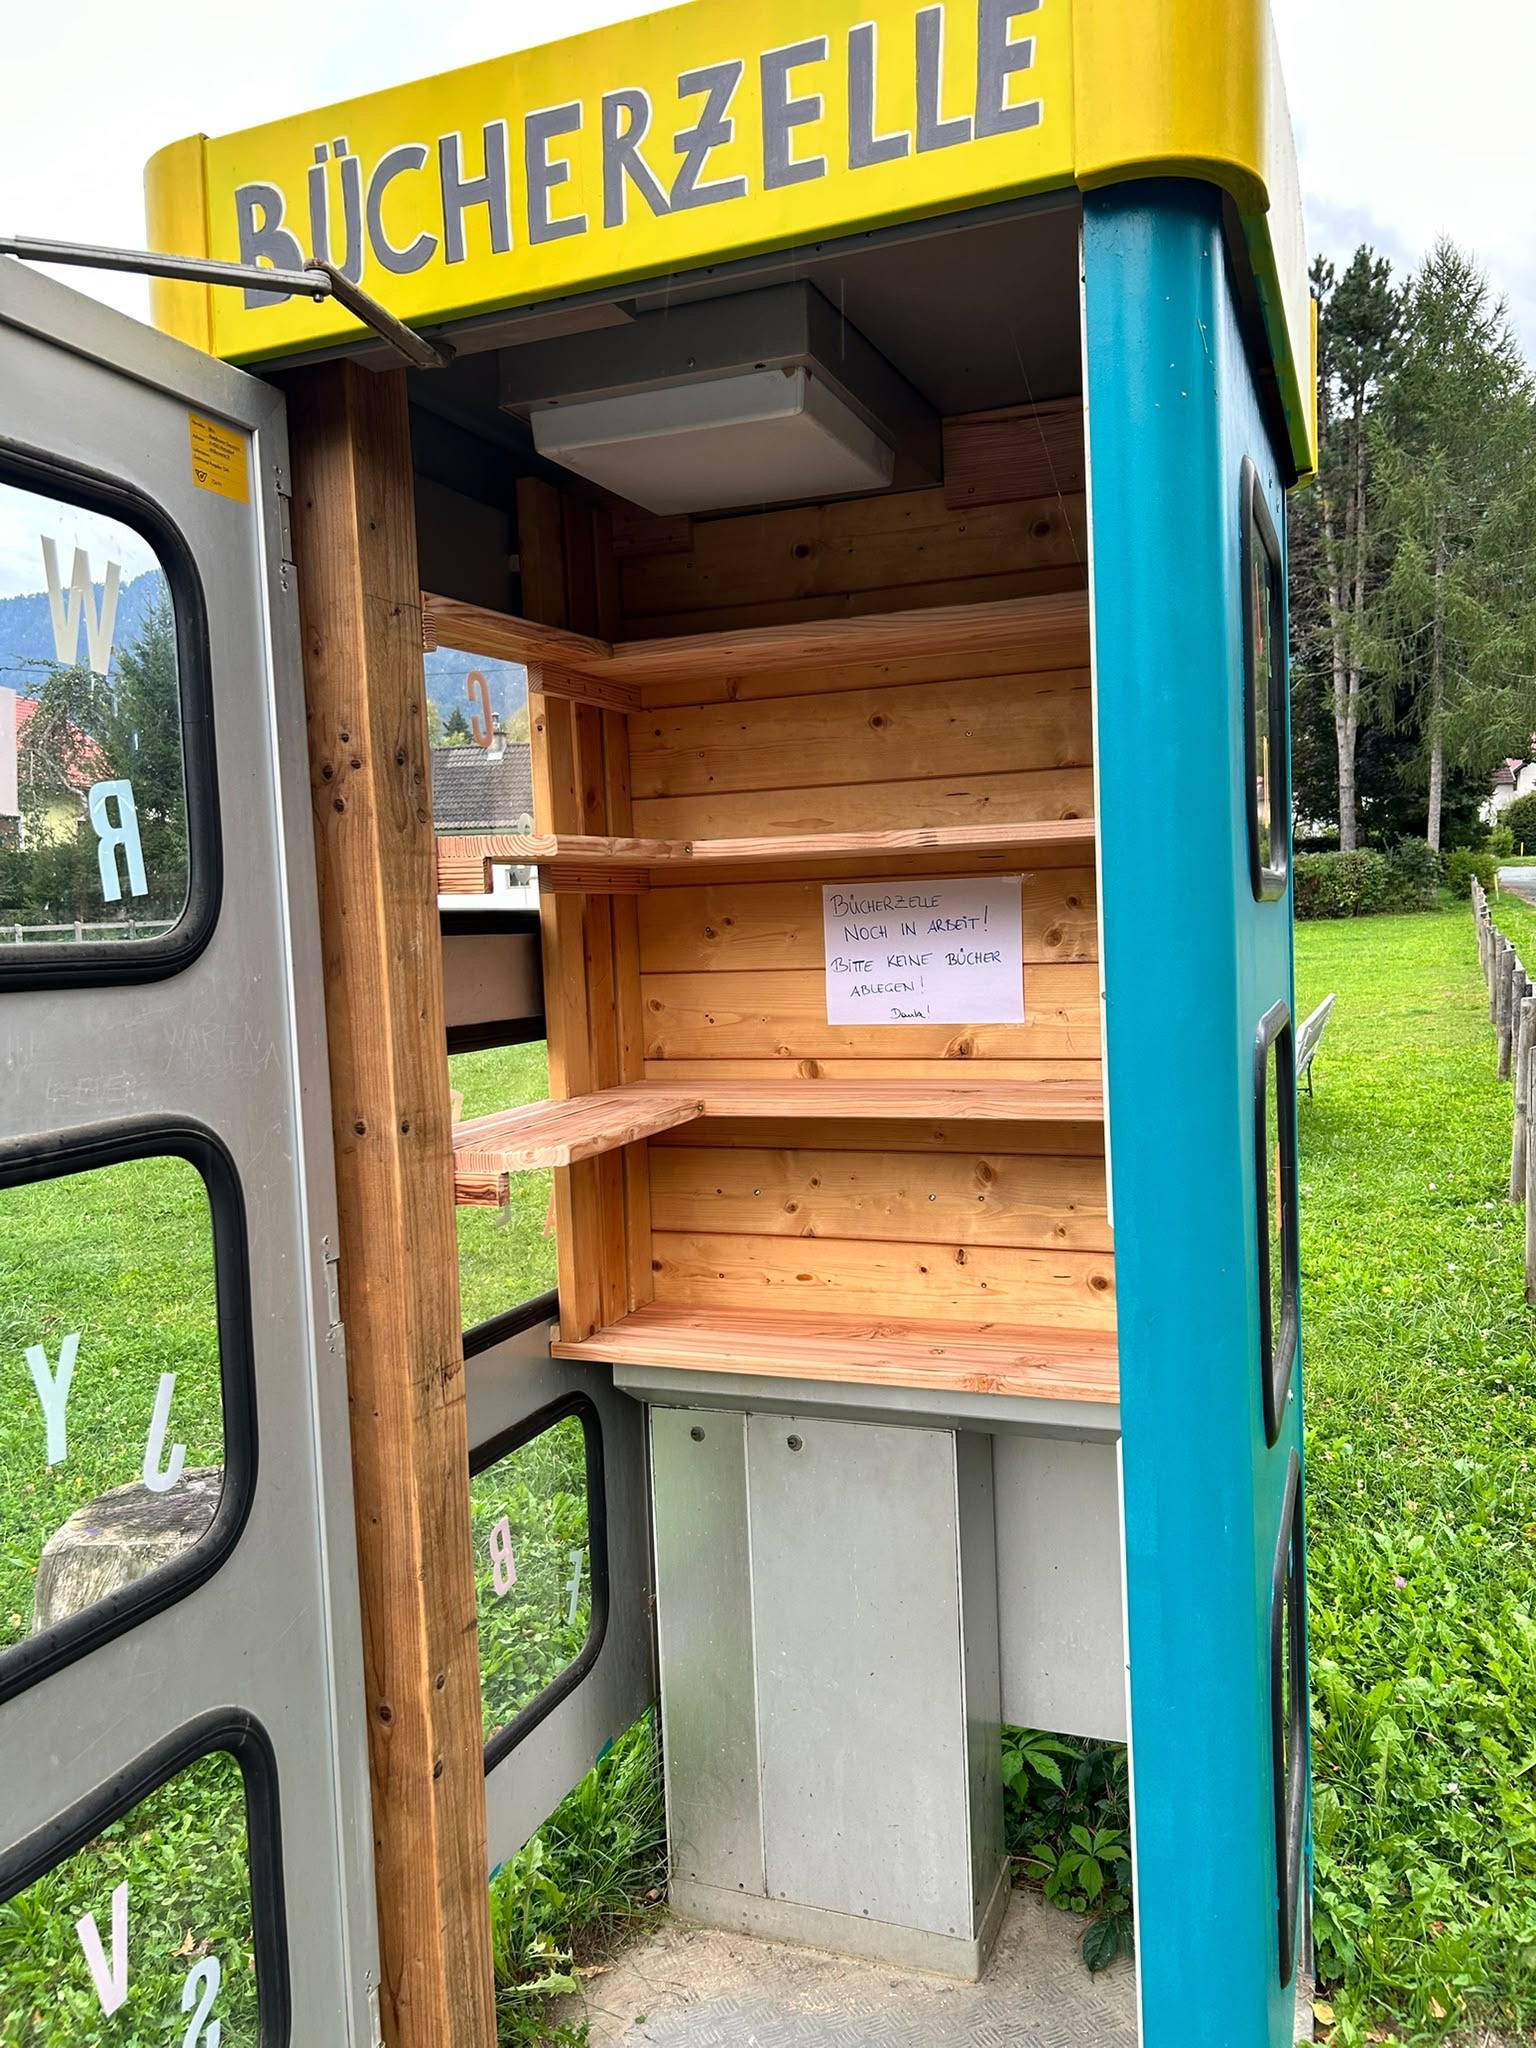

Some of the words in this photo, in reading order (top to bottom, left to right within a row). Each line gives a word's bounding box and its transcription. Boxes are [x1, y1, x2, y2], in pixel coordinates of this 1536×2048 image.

[235, 0, 1043, 310] BÜCHERZELLE
[830, 894, 942, 918] BÜCHERZELLE
[844, 926, 888, 943] NOCH
[901, 922, 917, 936] IN
[886, 952, 934, 969] KEINE
[944, 947, 1002, 967] BÜCHER
[24, 1332, 81, 1466] Y
[75, 1879, 129, 2019] V
